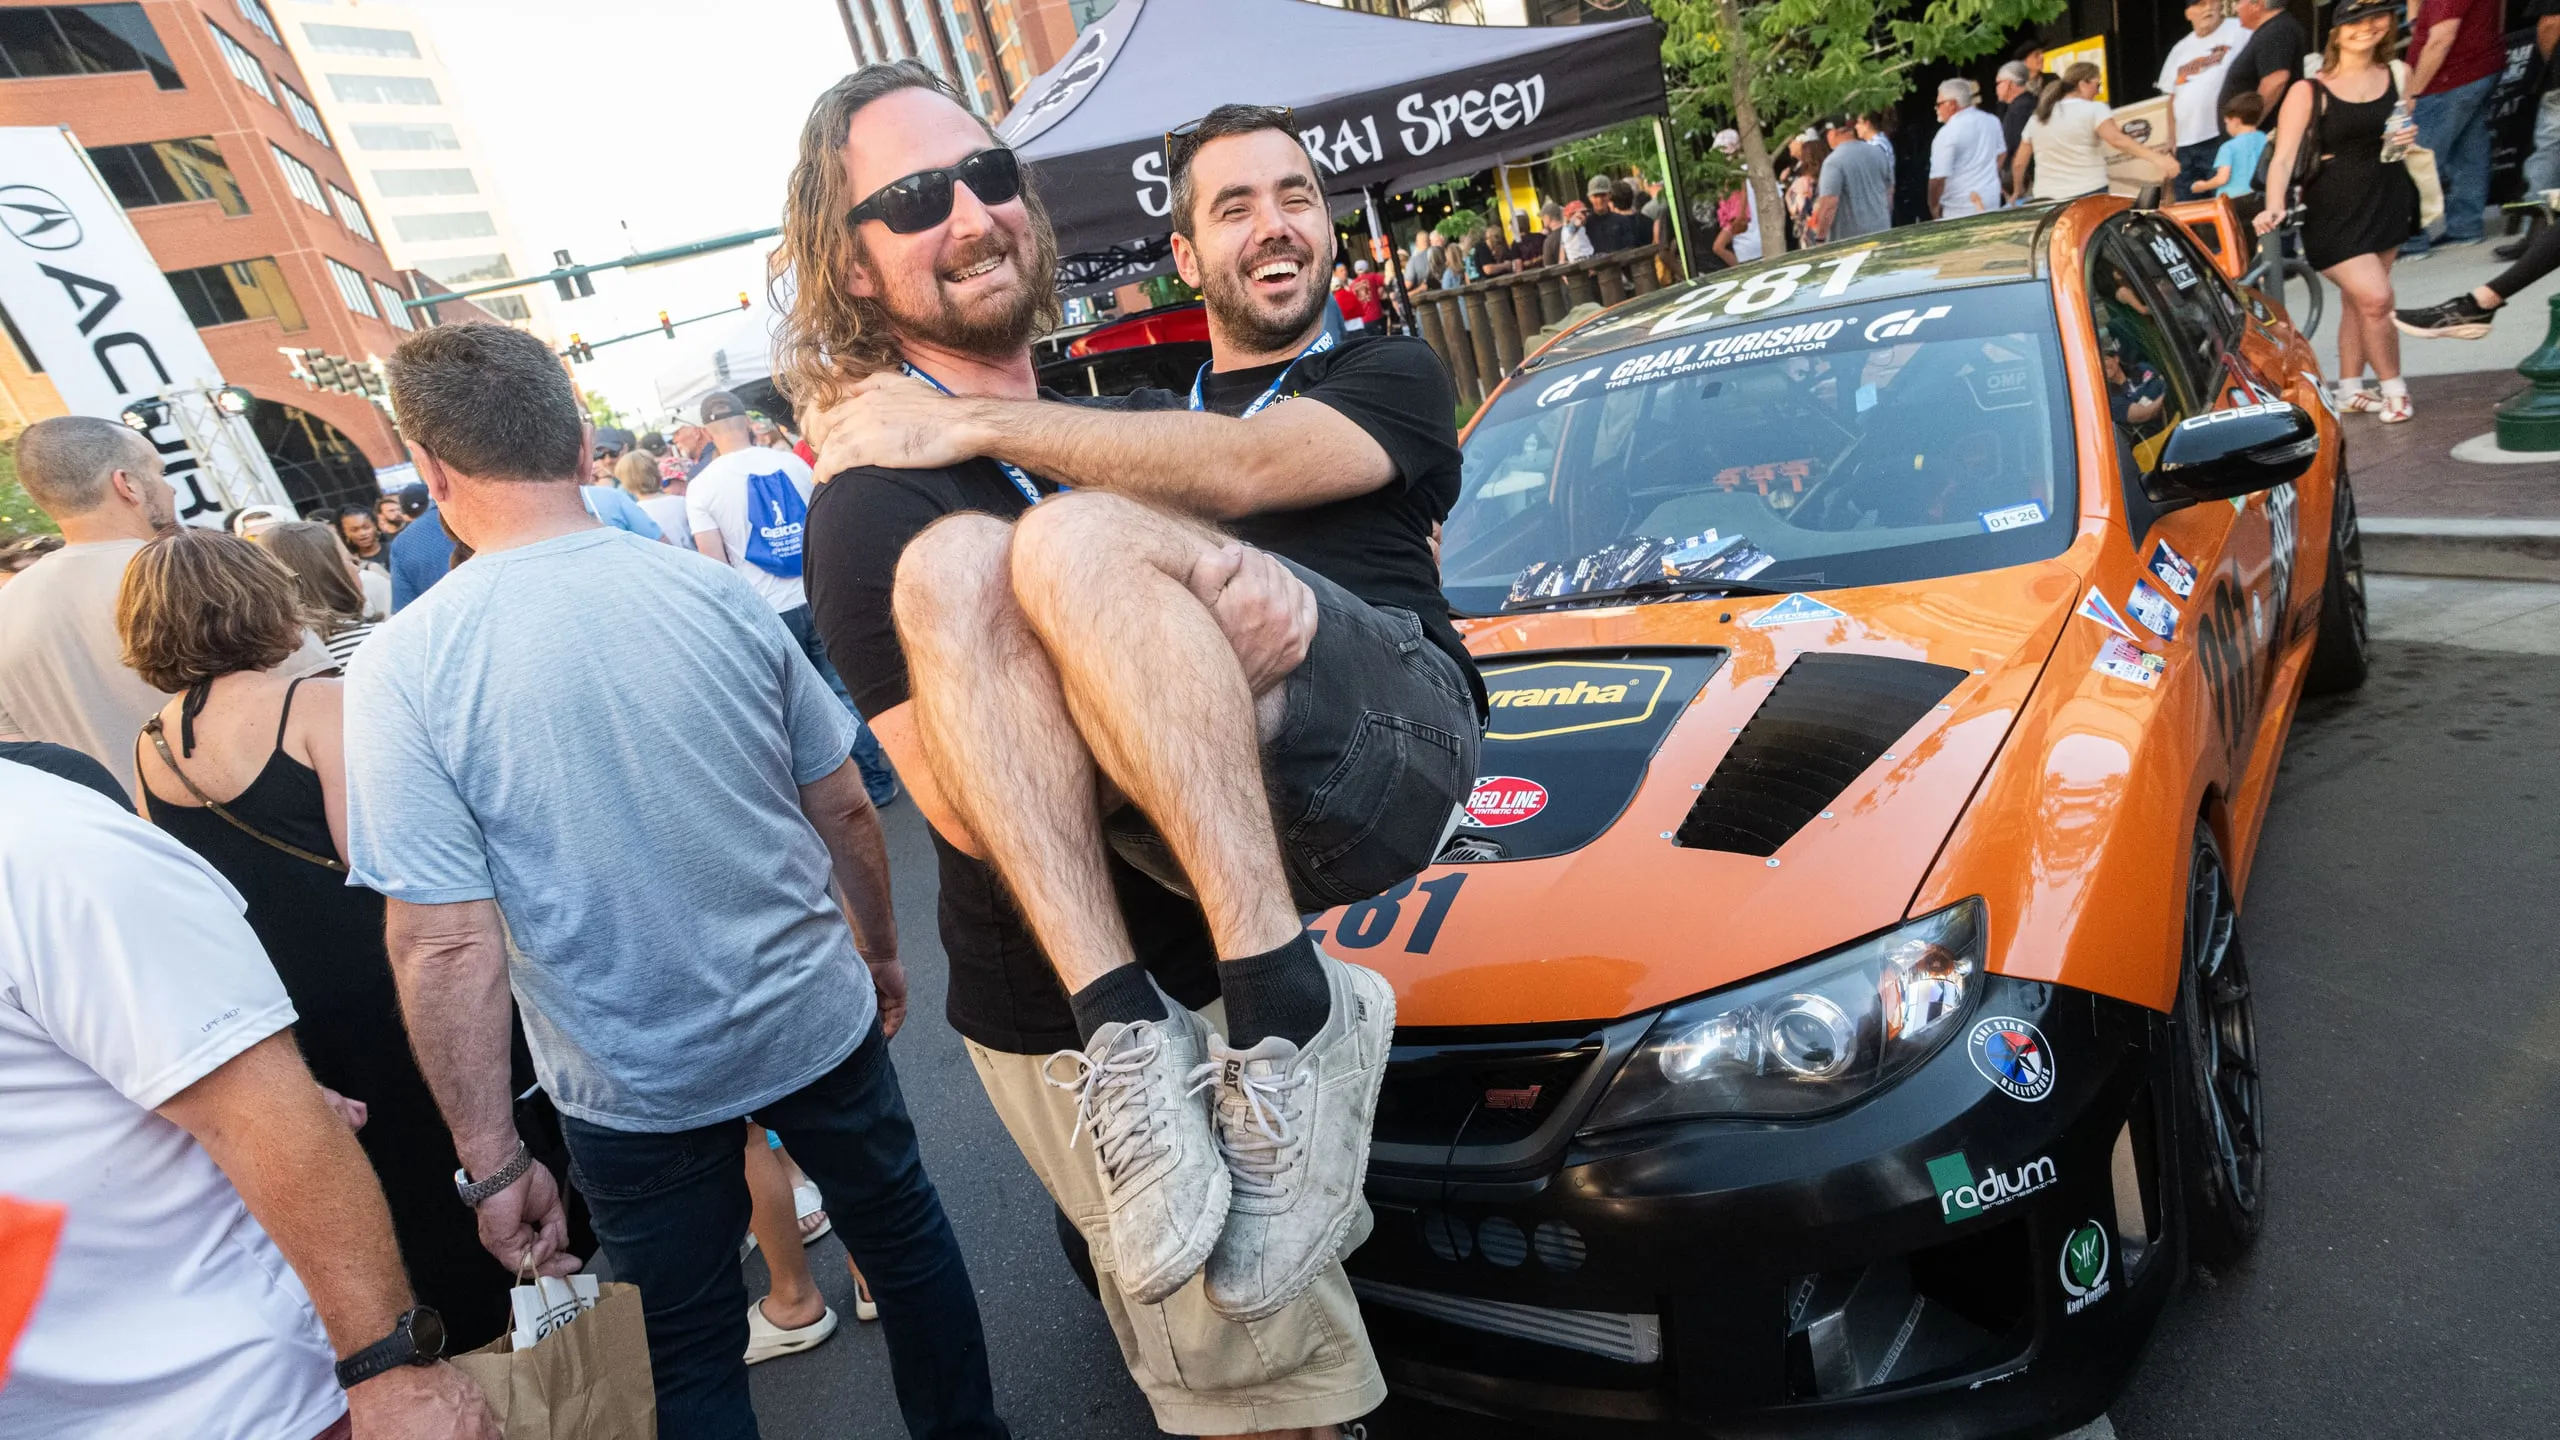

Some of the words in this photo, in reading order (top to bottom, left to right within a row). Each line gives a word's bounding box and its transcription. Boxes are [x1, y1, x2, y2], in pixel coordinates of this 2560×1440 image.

[1131, 114, 1384, 218] SRAI
[1649, 250, 1873, 336] 281
[1604, 379, 1631, 391] THE
[1633, 370, 1670, 386] REAL
[1671, 356, 1731, 377] DRIVING
[1734, 340, 1827, 365] SIMULATOR
[1610, 346, 1699, 381] GRAN
[1702, 318, 1840, 366] TURISMO
[35, 261, 223, 522] ACUR
[1987, 371, 2026, 388] OMP
[2182, 400, 2293, 431] COBB
[760, 522, 802, 538] GEICO
[2017, 509, 2039, 522] 26
[1465, 790, 1502, 809] RED
[1973, 1024, 1993, 1046] LONE
[1993, 1021, 2024, 1033] STAR
[1224, 1058, 1243, 1093] CAT
[2000, 1067, 2051, 1097] RALLYCROSS
[1941, 1155, 2057, 1216] radium
